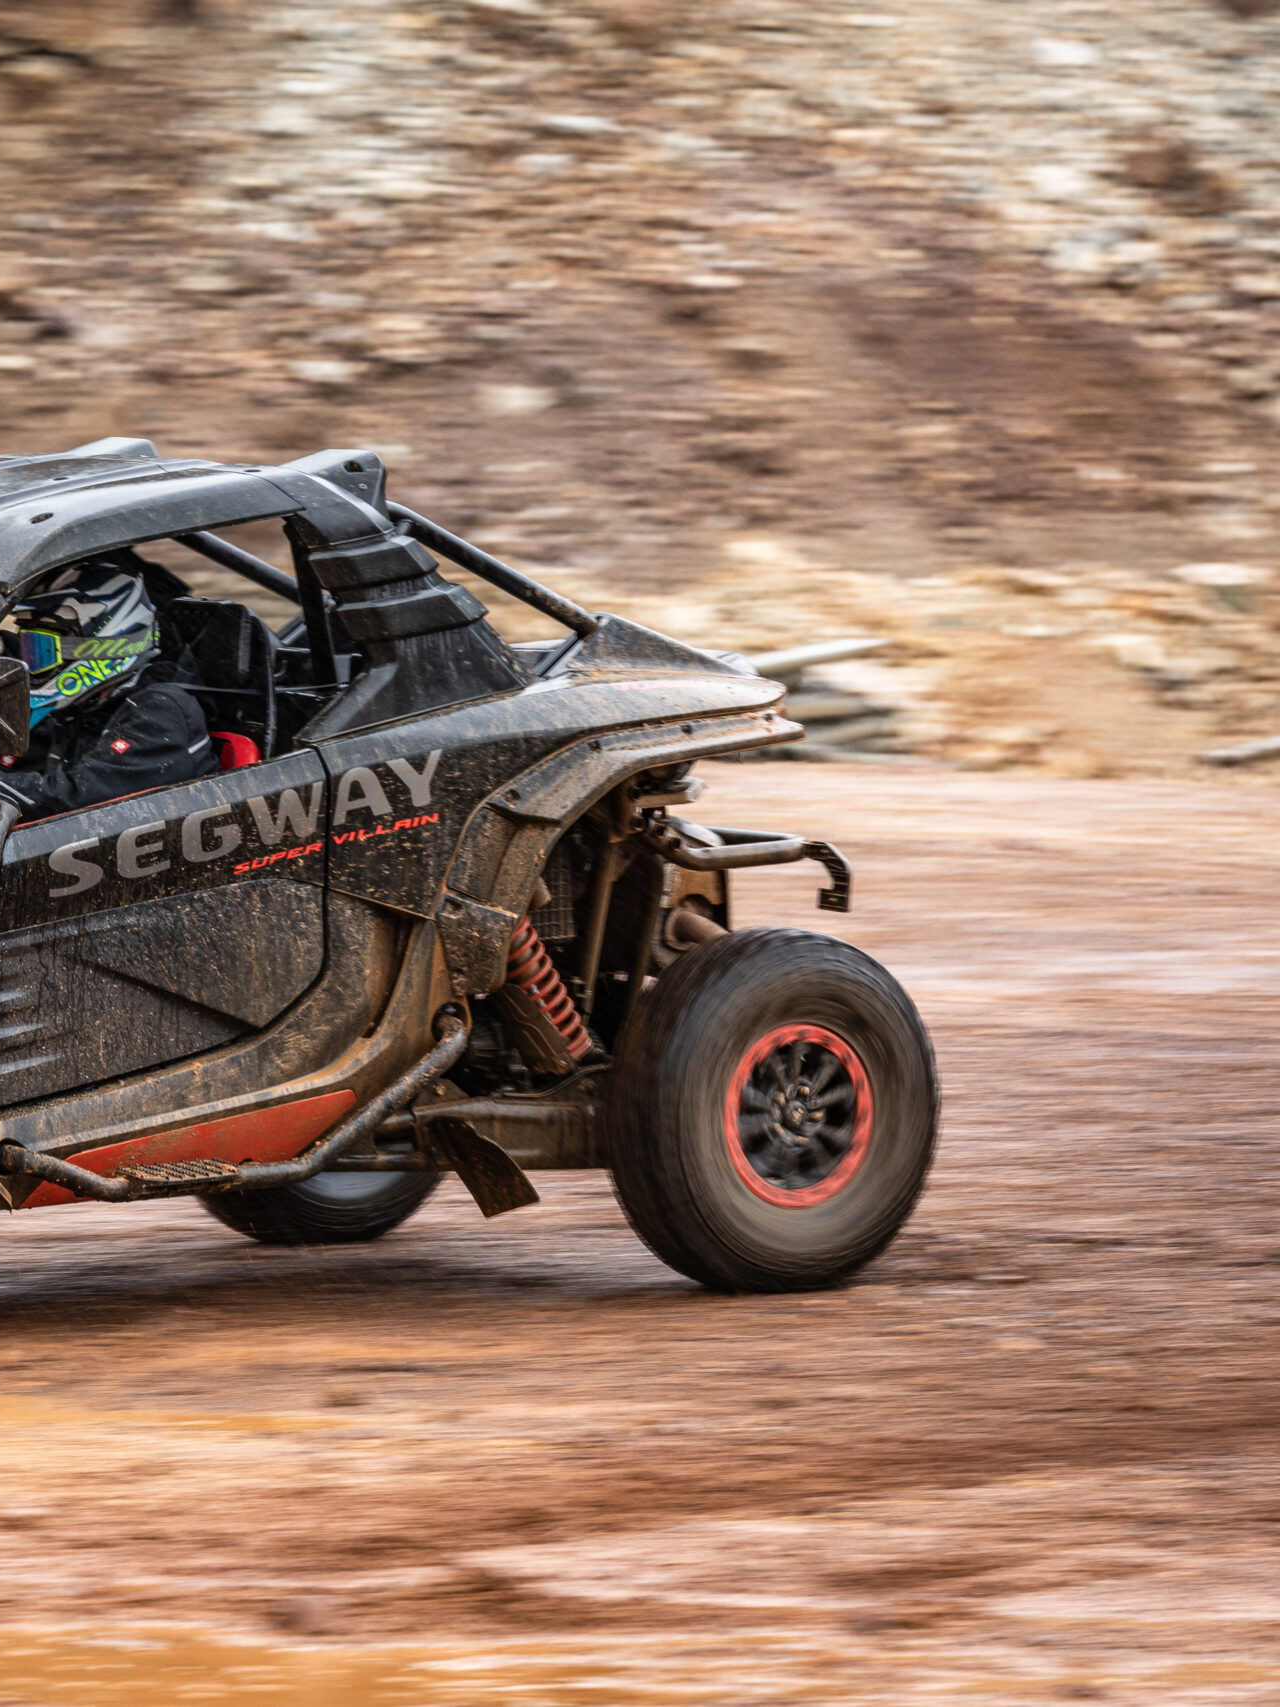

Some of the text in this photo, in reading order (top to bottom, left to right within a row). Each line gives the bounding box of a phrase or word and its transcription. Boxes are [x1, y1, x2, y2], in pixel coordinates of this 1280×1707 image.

[48, 749, 443, 898] SEGWAY
[233, 812, 440, 875] SUPER VILLAIN
